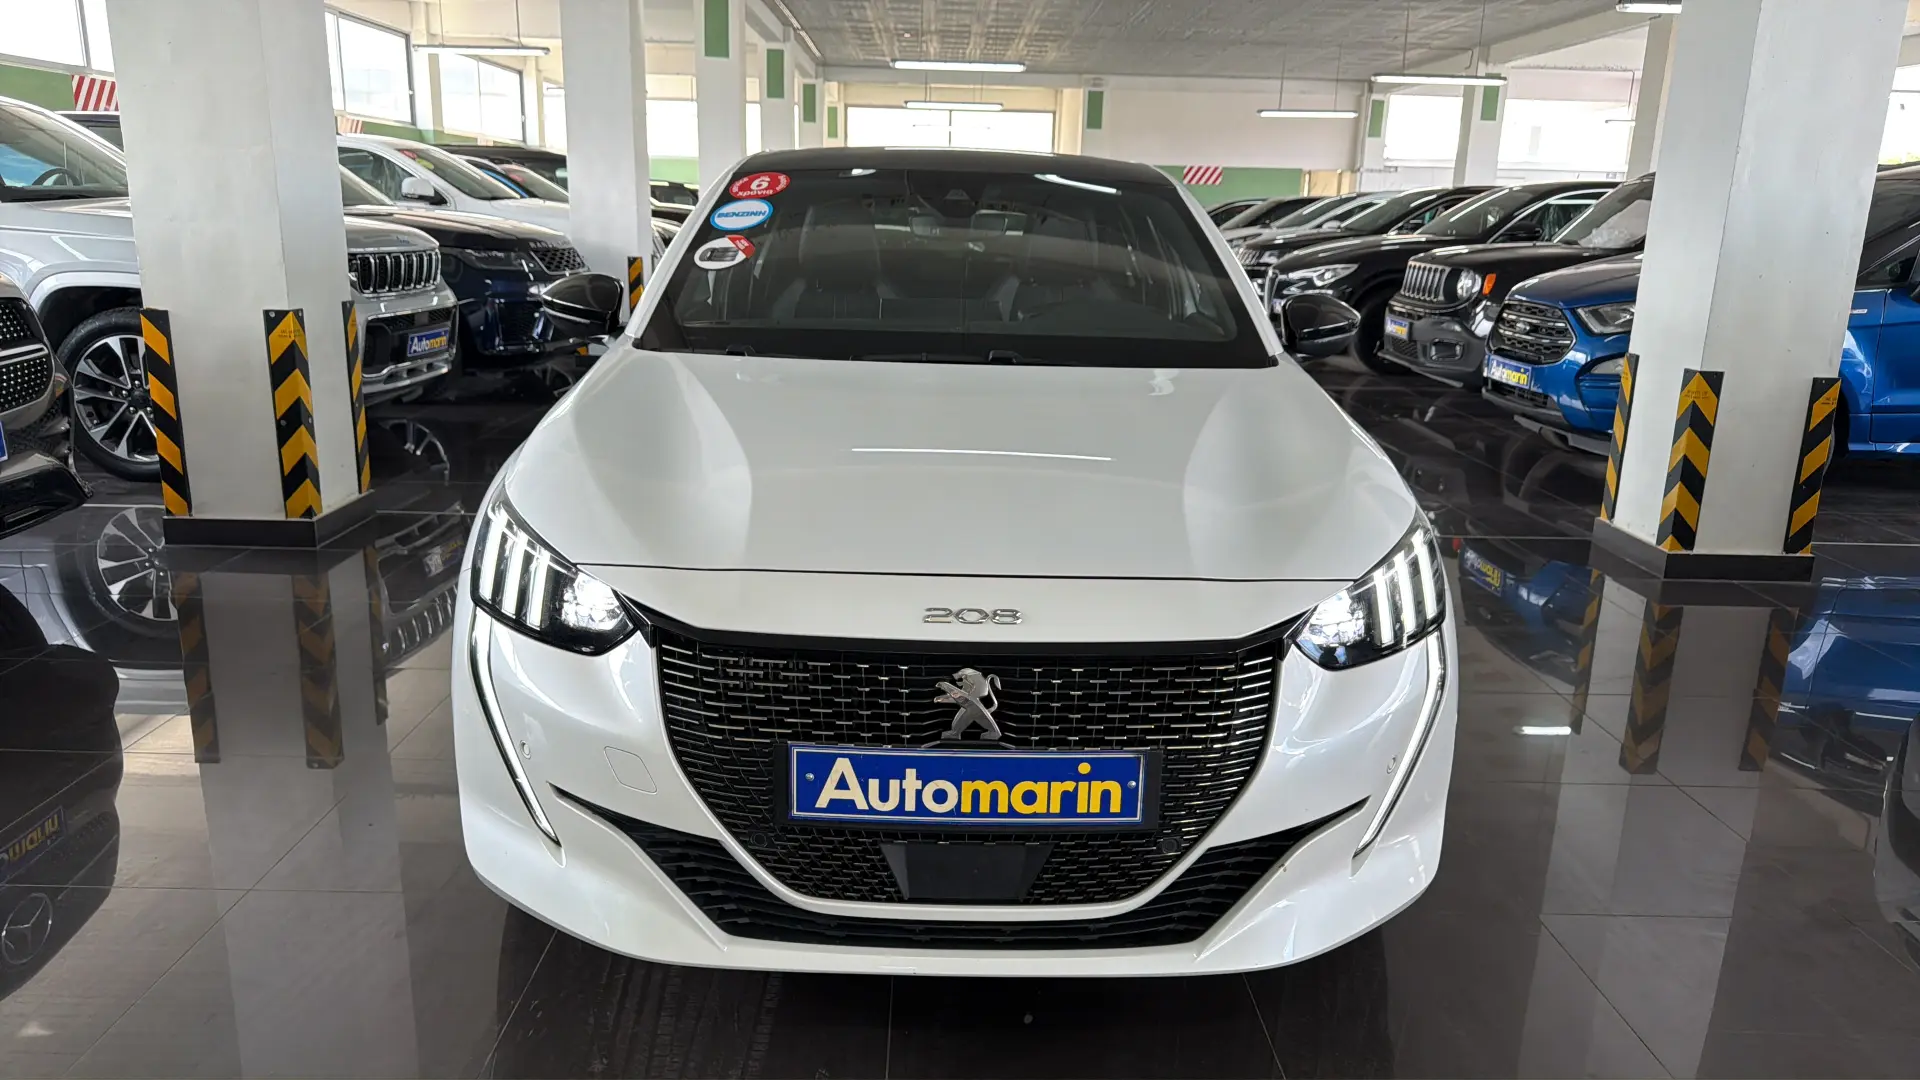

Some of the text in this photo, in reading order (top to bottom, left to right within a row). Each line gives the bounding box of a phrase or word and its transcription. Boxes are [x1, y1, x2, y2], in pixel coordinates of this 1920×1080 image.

[750, 177, 771, 191] 6
[411, 332, 447, 353] Automarin
[1491, 361, 1528, 386] Automarin
[923, 607, 1022, 624] 208
[815, 757, 1122, 815] Automarin
